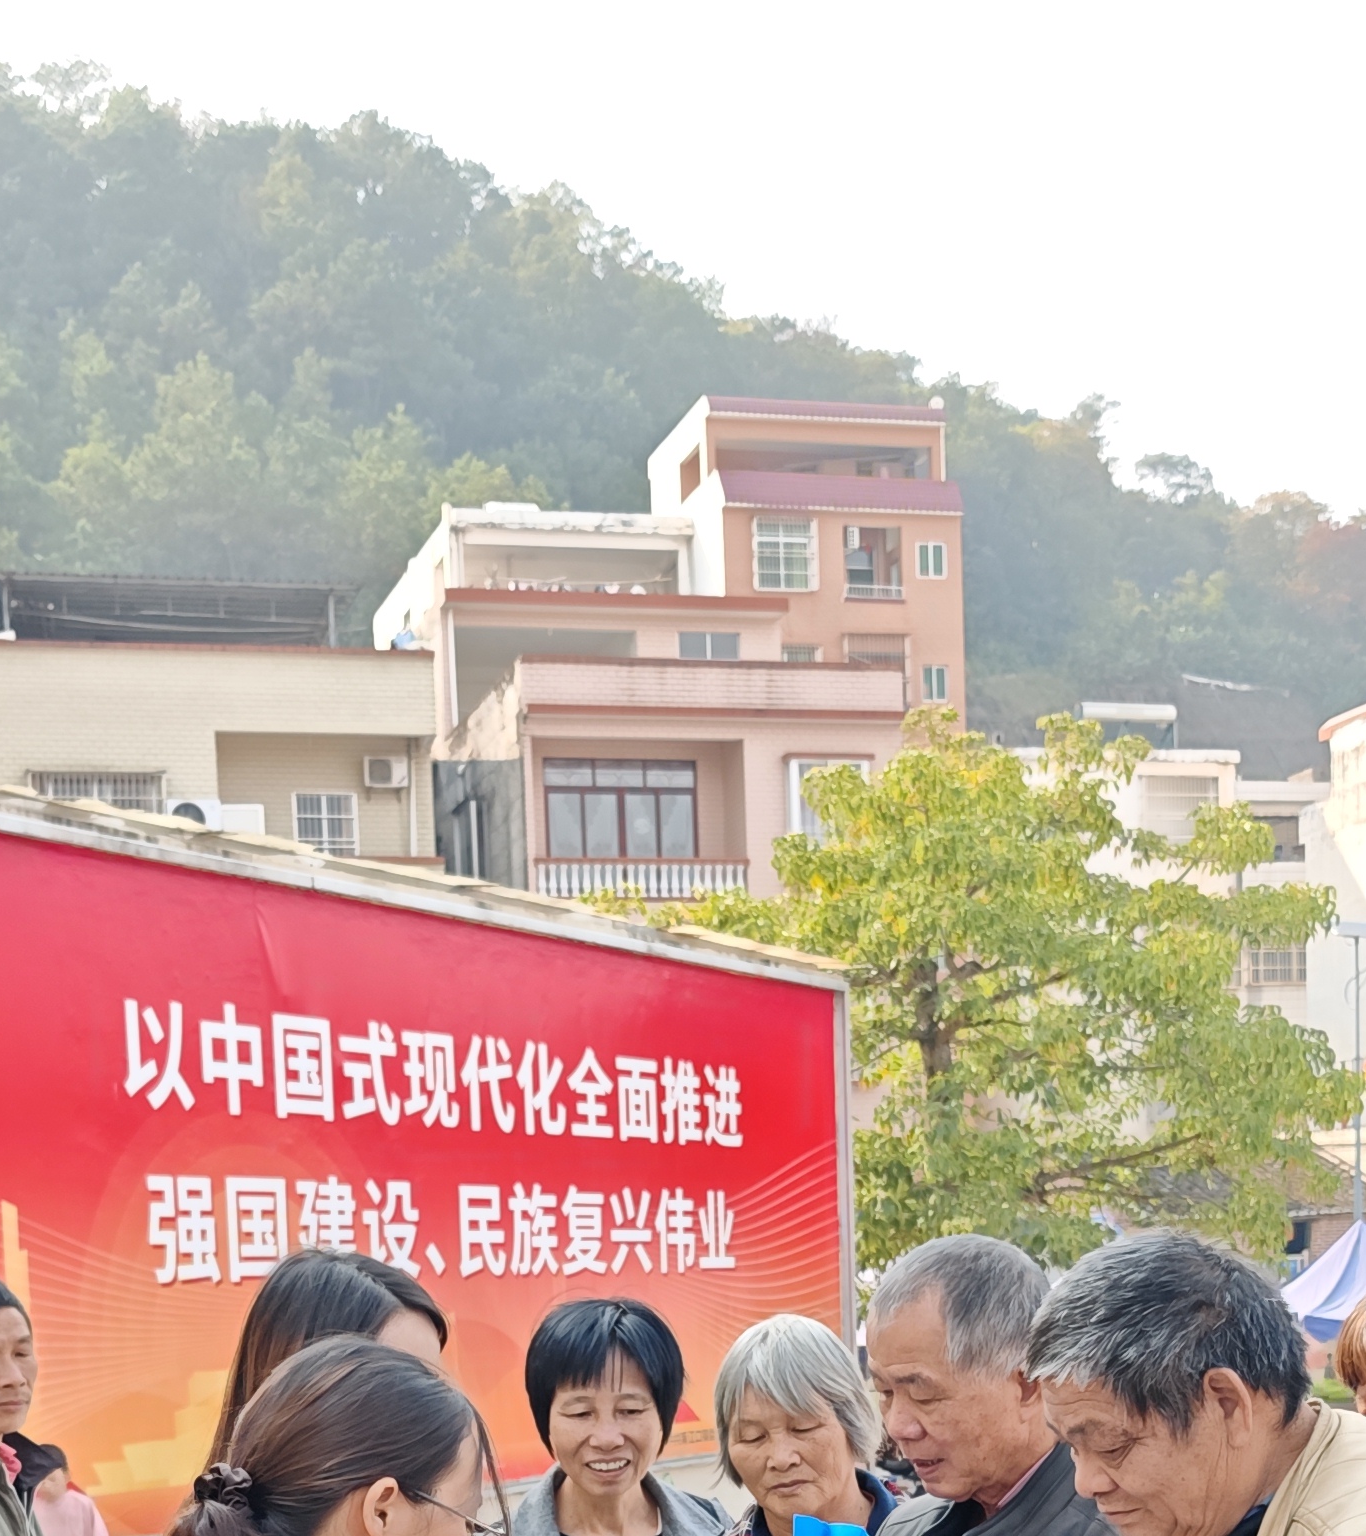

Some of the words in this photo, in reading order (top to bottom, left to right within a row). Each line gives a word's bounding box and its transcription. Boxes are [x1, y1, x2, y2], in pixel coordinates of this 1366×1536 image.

[123, 998, 743, 1148] 以中国式现代化全面推进
[147, 1174, 736, 1285] 强国建设、民族复兴伟业
